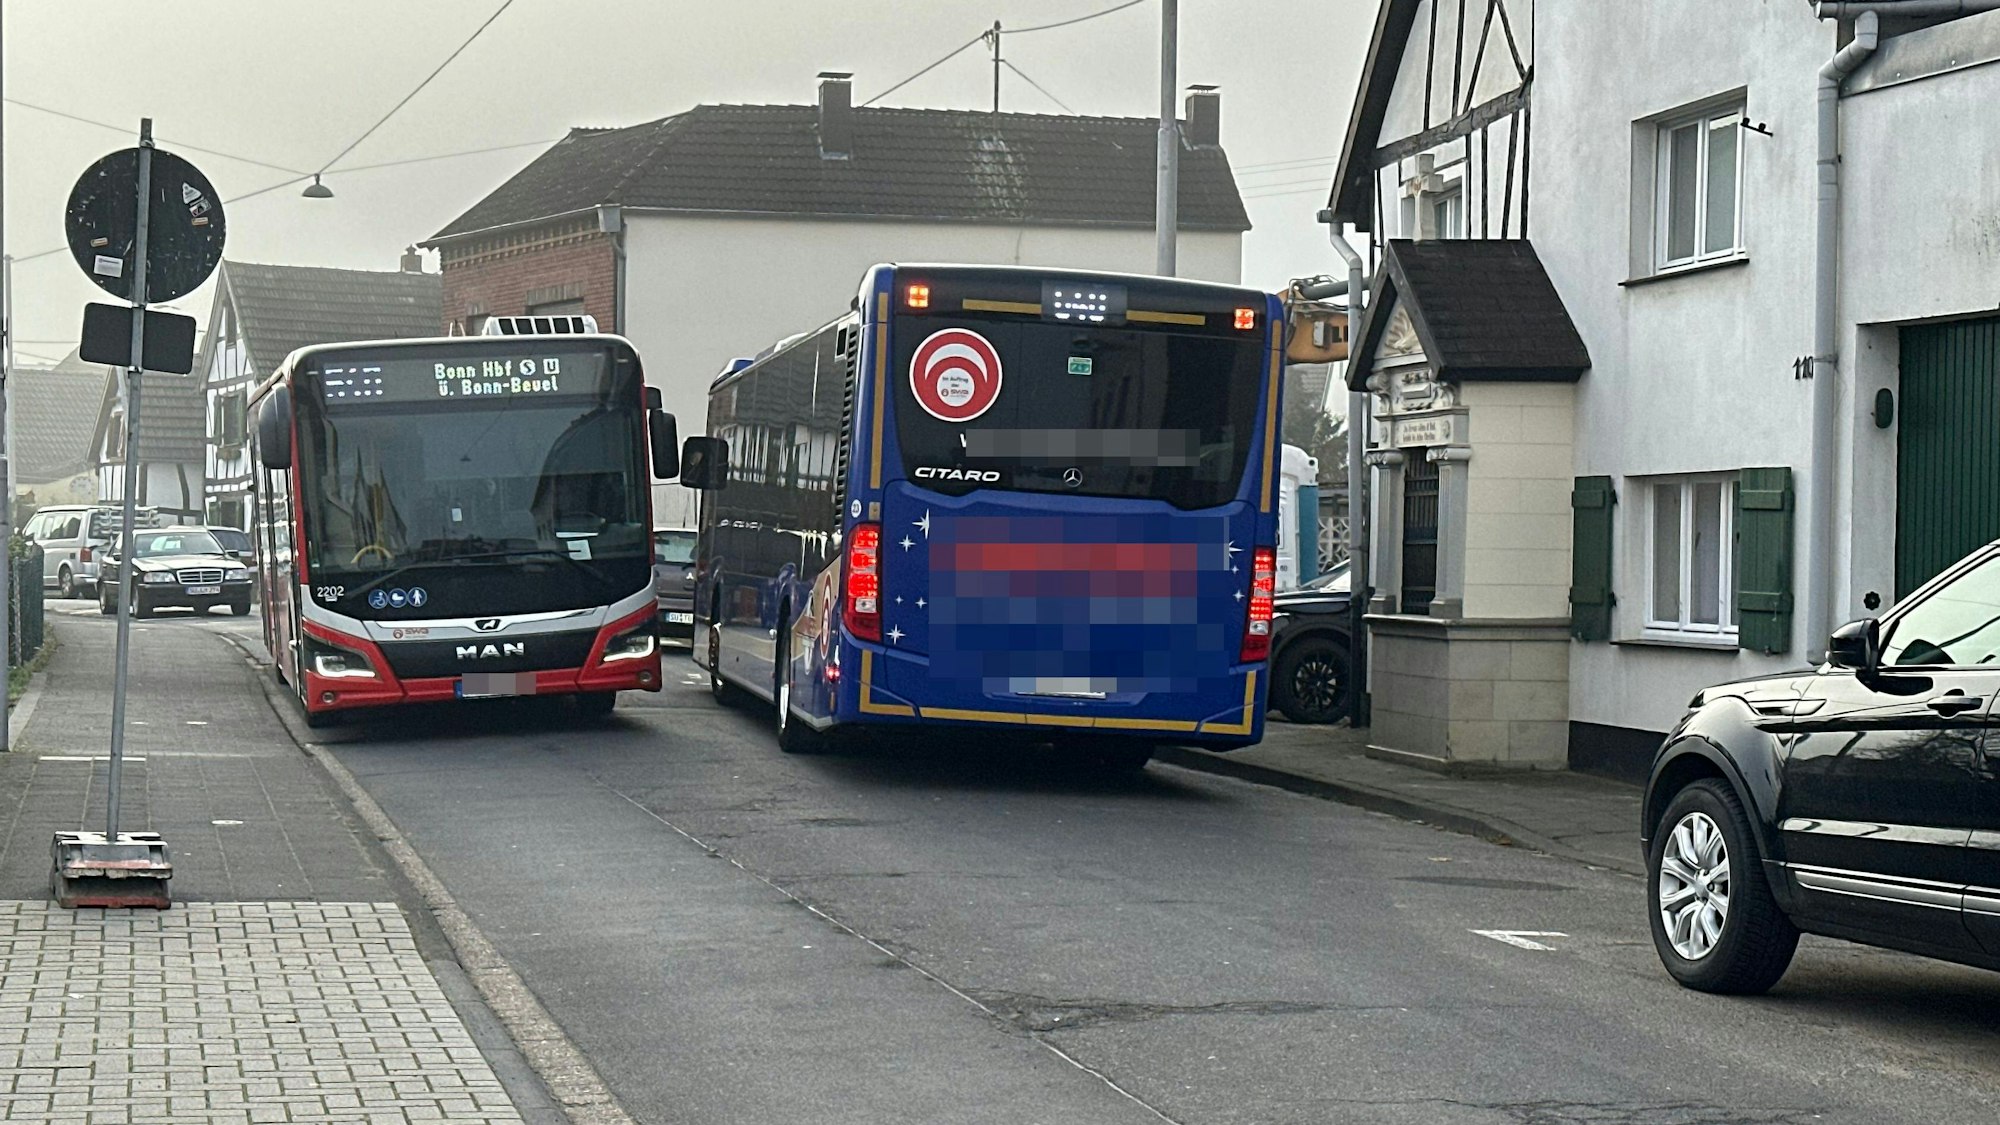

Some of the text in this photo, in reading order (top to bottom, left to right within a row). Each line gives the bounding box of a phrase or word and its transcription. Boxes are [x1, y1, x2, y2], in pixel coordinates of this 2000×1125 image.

[434, 363, 476, 379] Bonn
[482, 360, 512, 377] Hbf
[1792, 355, 1813, 380] 110
[461, 375, 558, 395] Bonn-Beuel
[915, 467, 1000, 482] CITARO
[317, 586, 344, 597] 2202
[456, 642, 525, 659] MAN
